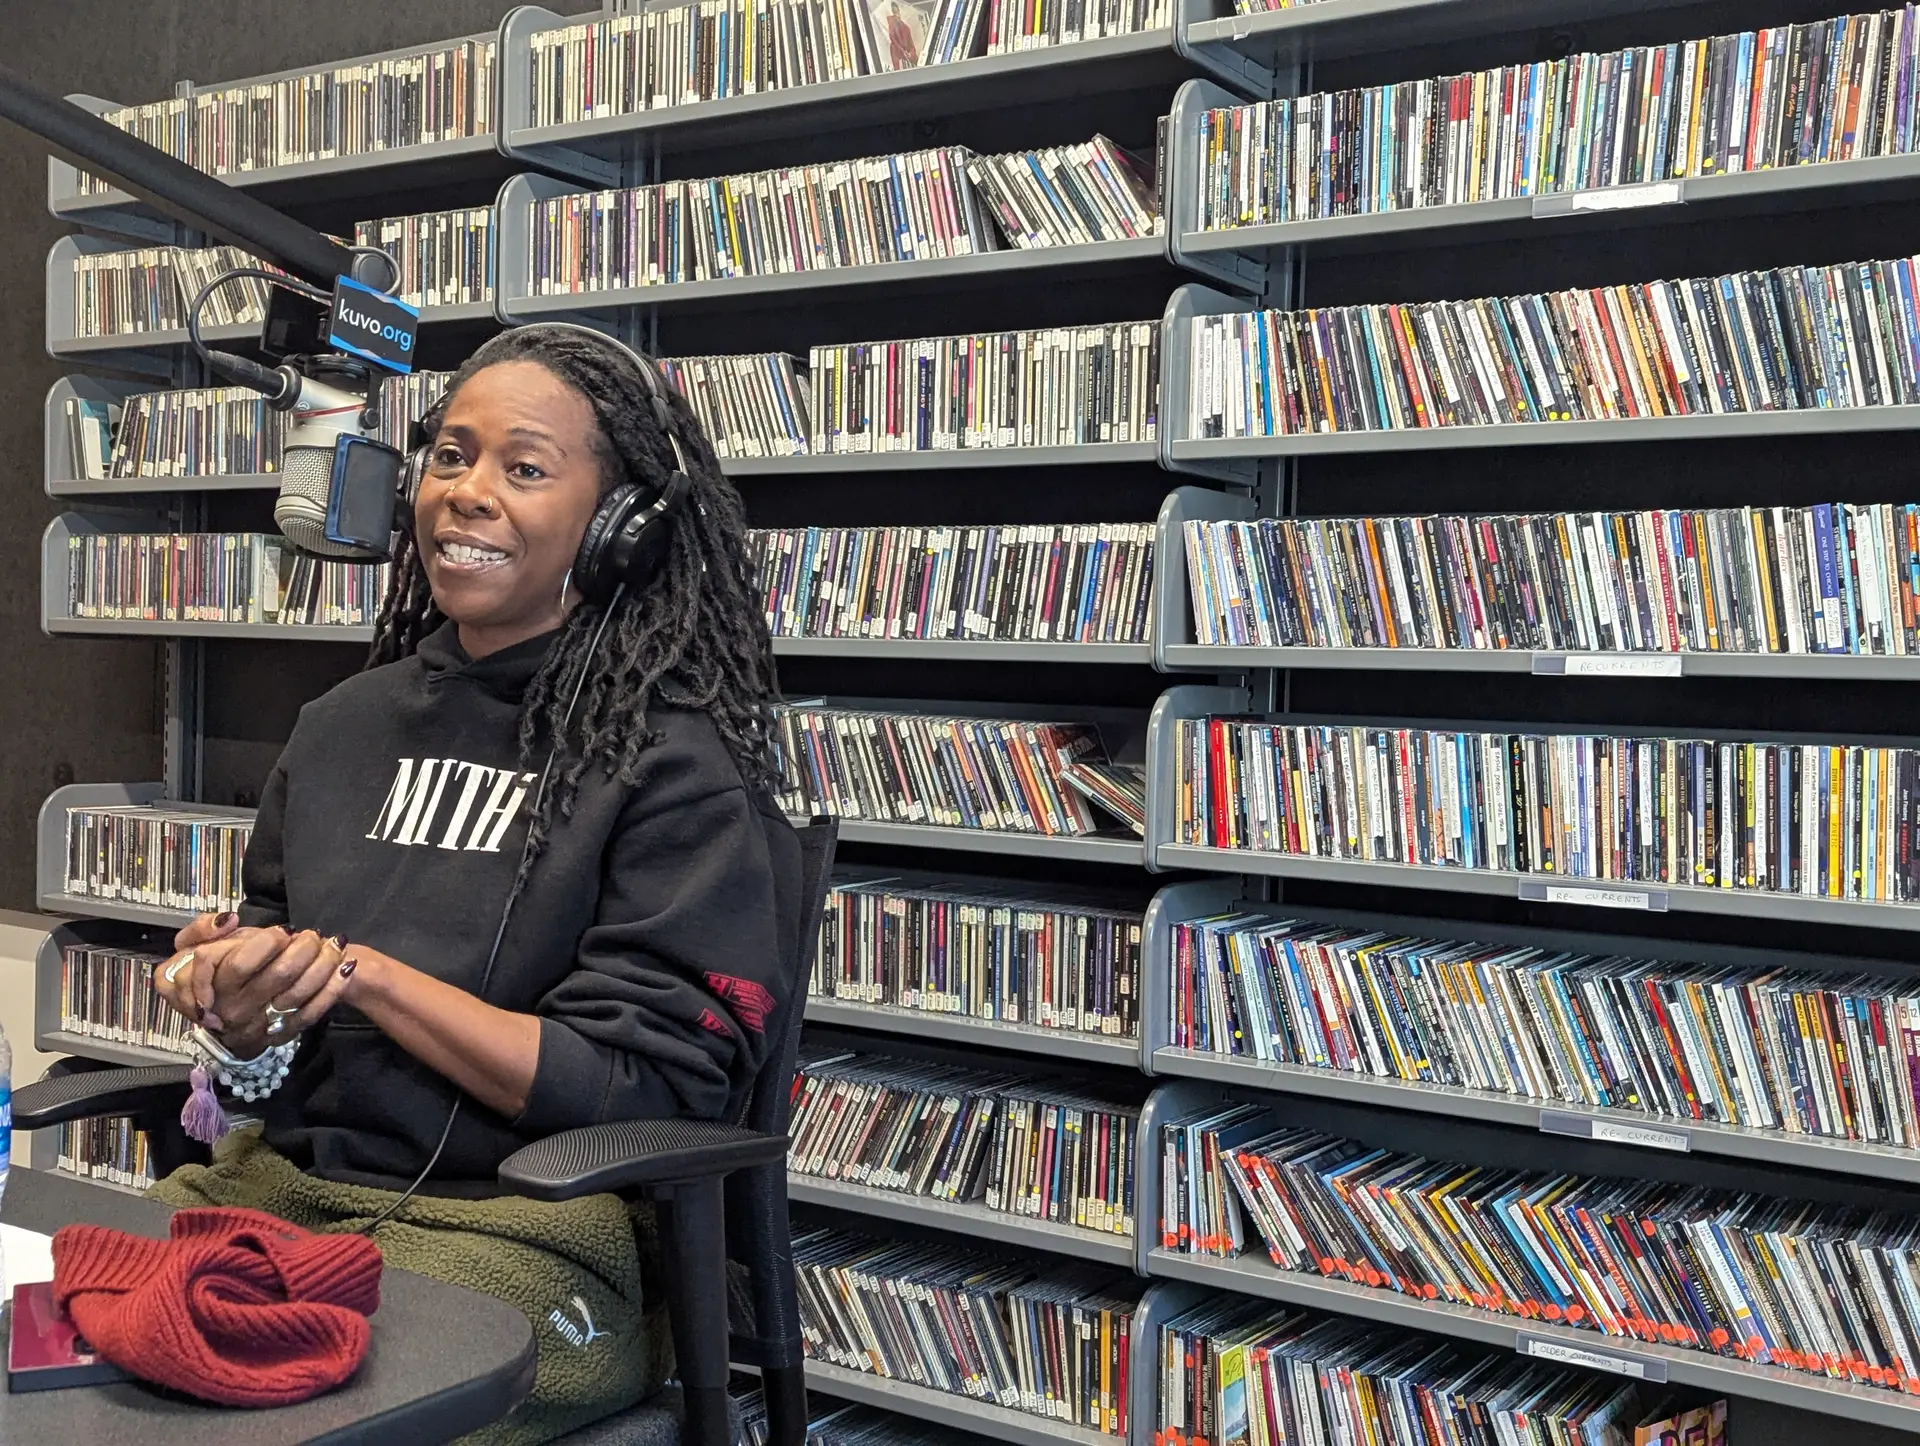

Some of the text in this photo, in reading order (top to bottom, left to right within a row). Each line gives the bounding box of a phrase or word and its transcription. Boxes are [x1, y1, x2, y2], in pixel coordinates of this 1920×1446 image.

[338, 298, 412, 352] kuvo.org
[1778, 533, 1786, 554] dear
[1888, 546, 1897, 574] Standards
[1580, 660, 1664, 672] RECURRENTS
[1584, 892, 1642, 903] CURRENTS
[1293, 973, 1306, 1004] COSTA AZUL
[1900, 1006, 1908, 1019] 5
[1910, 1008, 1918, 1018] 12
[1627, 1131, 1685, 1144] CURRENTS
[1855, 1259, 1865, 1281] Noah
[1875, 1311, 1894, 1352] Standards
[548, 1310, 584, 1346] PUMA
[1540, 1346, 1567, 1358] OLDER
